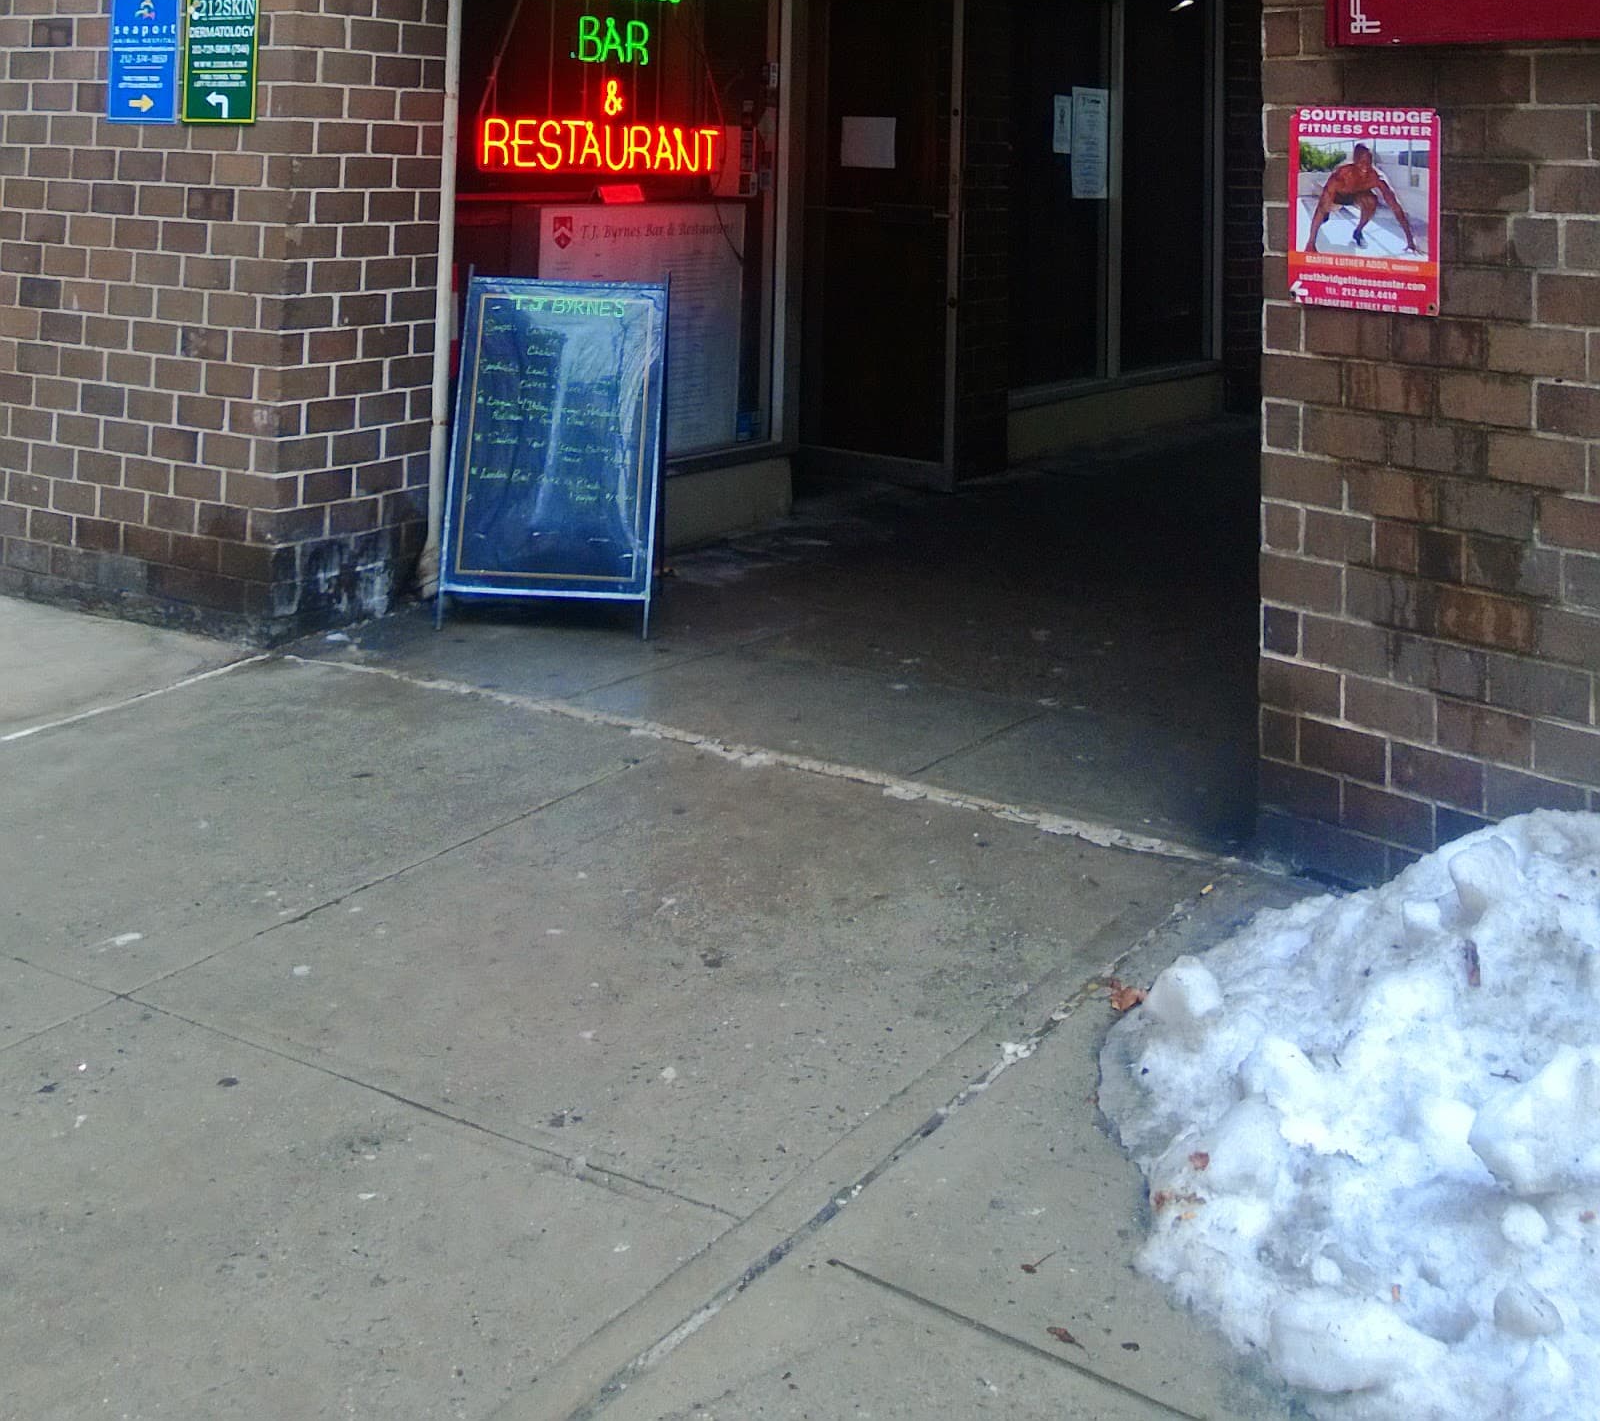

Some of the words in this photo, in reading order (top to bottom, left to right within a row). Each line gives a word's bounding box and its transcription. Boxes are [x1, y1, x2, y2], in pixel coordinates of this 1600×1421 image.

[114, 24, 176, 37] seaport
[189, 25, 255, 38] DERMATOLOGY
[578, 15, 649, 65] BAR
[604, 80, 623, 115] &
[1299, 108, 1433, 124] SOUTHBRIDGE
[1298, 124, 1363, 135] FITNESS
[1368, 125, 1432, 136] CENTER
[483, 118, 720, 172] RESTAURANT
[551, 297, 626, 318] BYRNES
